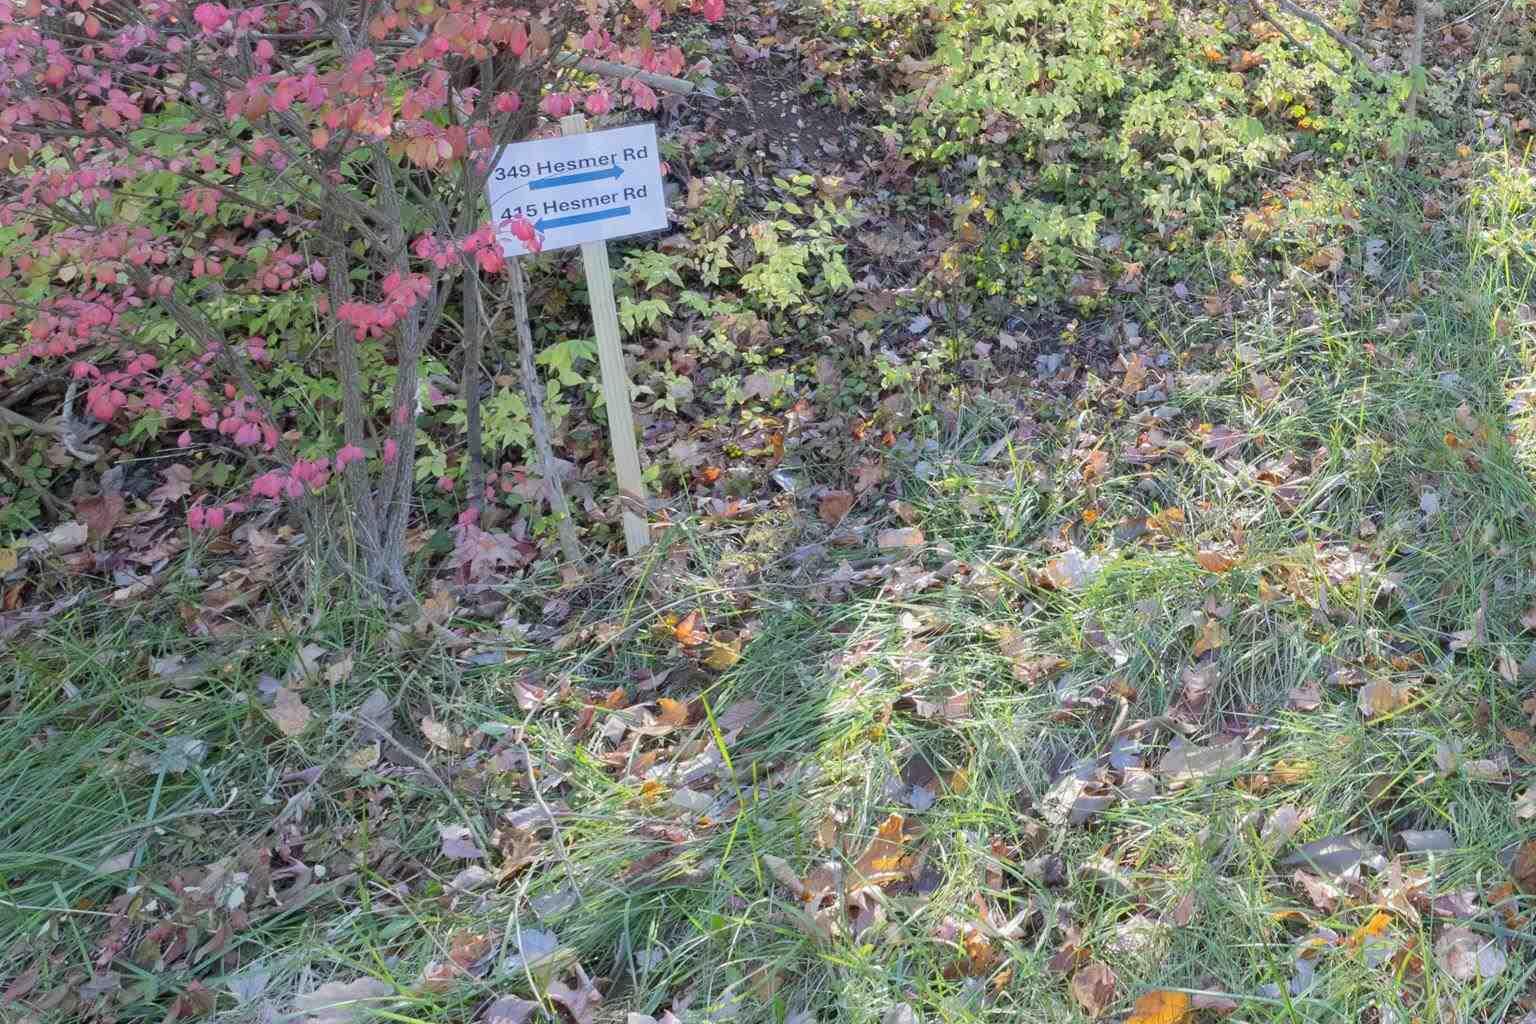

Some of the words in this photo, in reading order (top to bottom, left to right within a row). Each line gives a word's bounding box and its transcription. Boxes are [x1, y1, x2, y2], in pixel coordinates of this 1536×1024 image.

[495, 164, 530, 181] 349
[537, 151, 618, 175] Hesmer
[623, 146, 648, 162] Rd
[501, 204, 537, 220] 415
[543, 191, 618, 215] Hesmer
[623, 185, 648, 201] Rd
